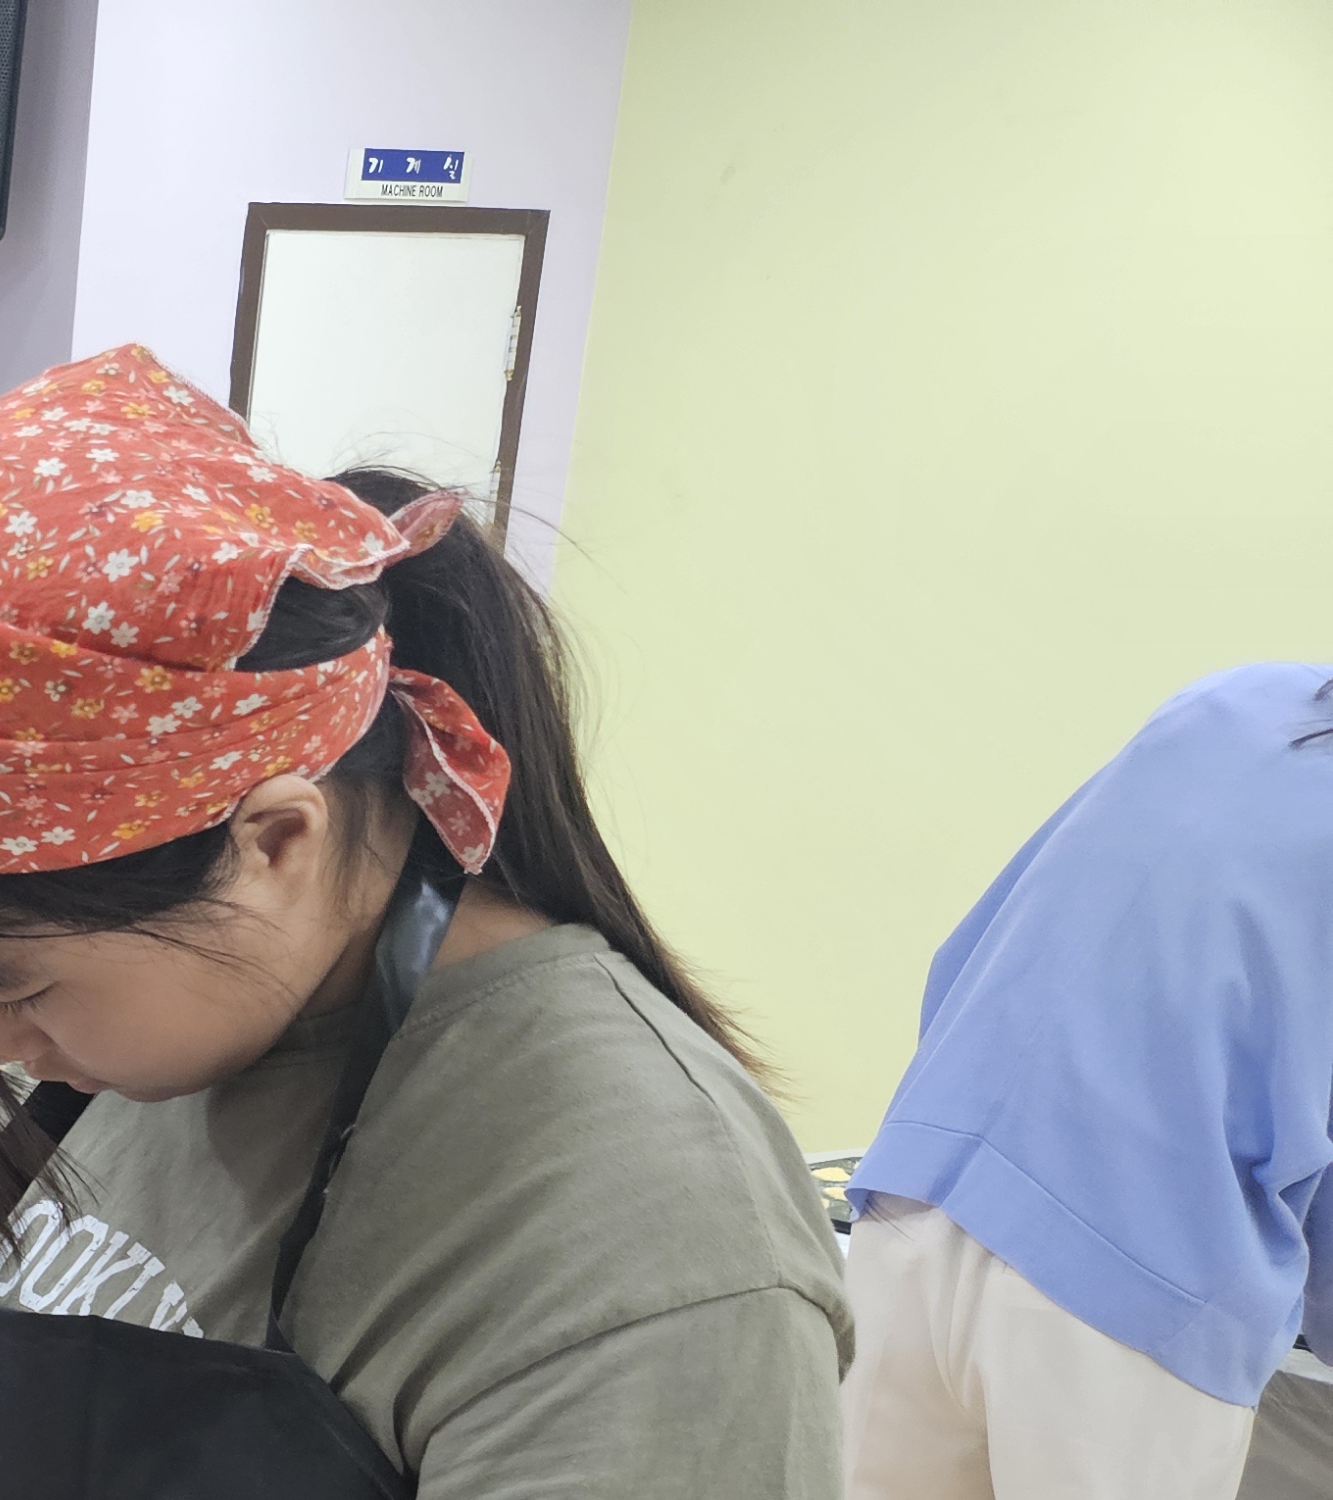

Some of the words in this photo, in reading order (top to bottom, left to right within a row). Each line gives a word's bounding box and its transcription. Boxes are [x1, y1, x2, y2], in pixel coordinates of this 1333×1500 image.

[369, 154, 459, 180] 기계실
[381, 184, 416, 197] MACHINE
[418, 185, 443, 198] ROOM
